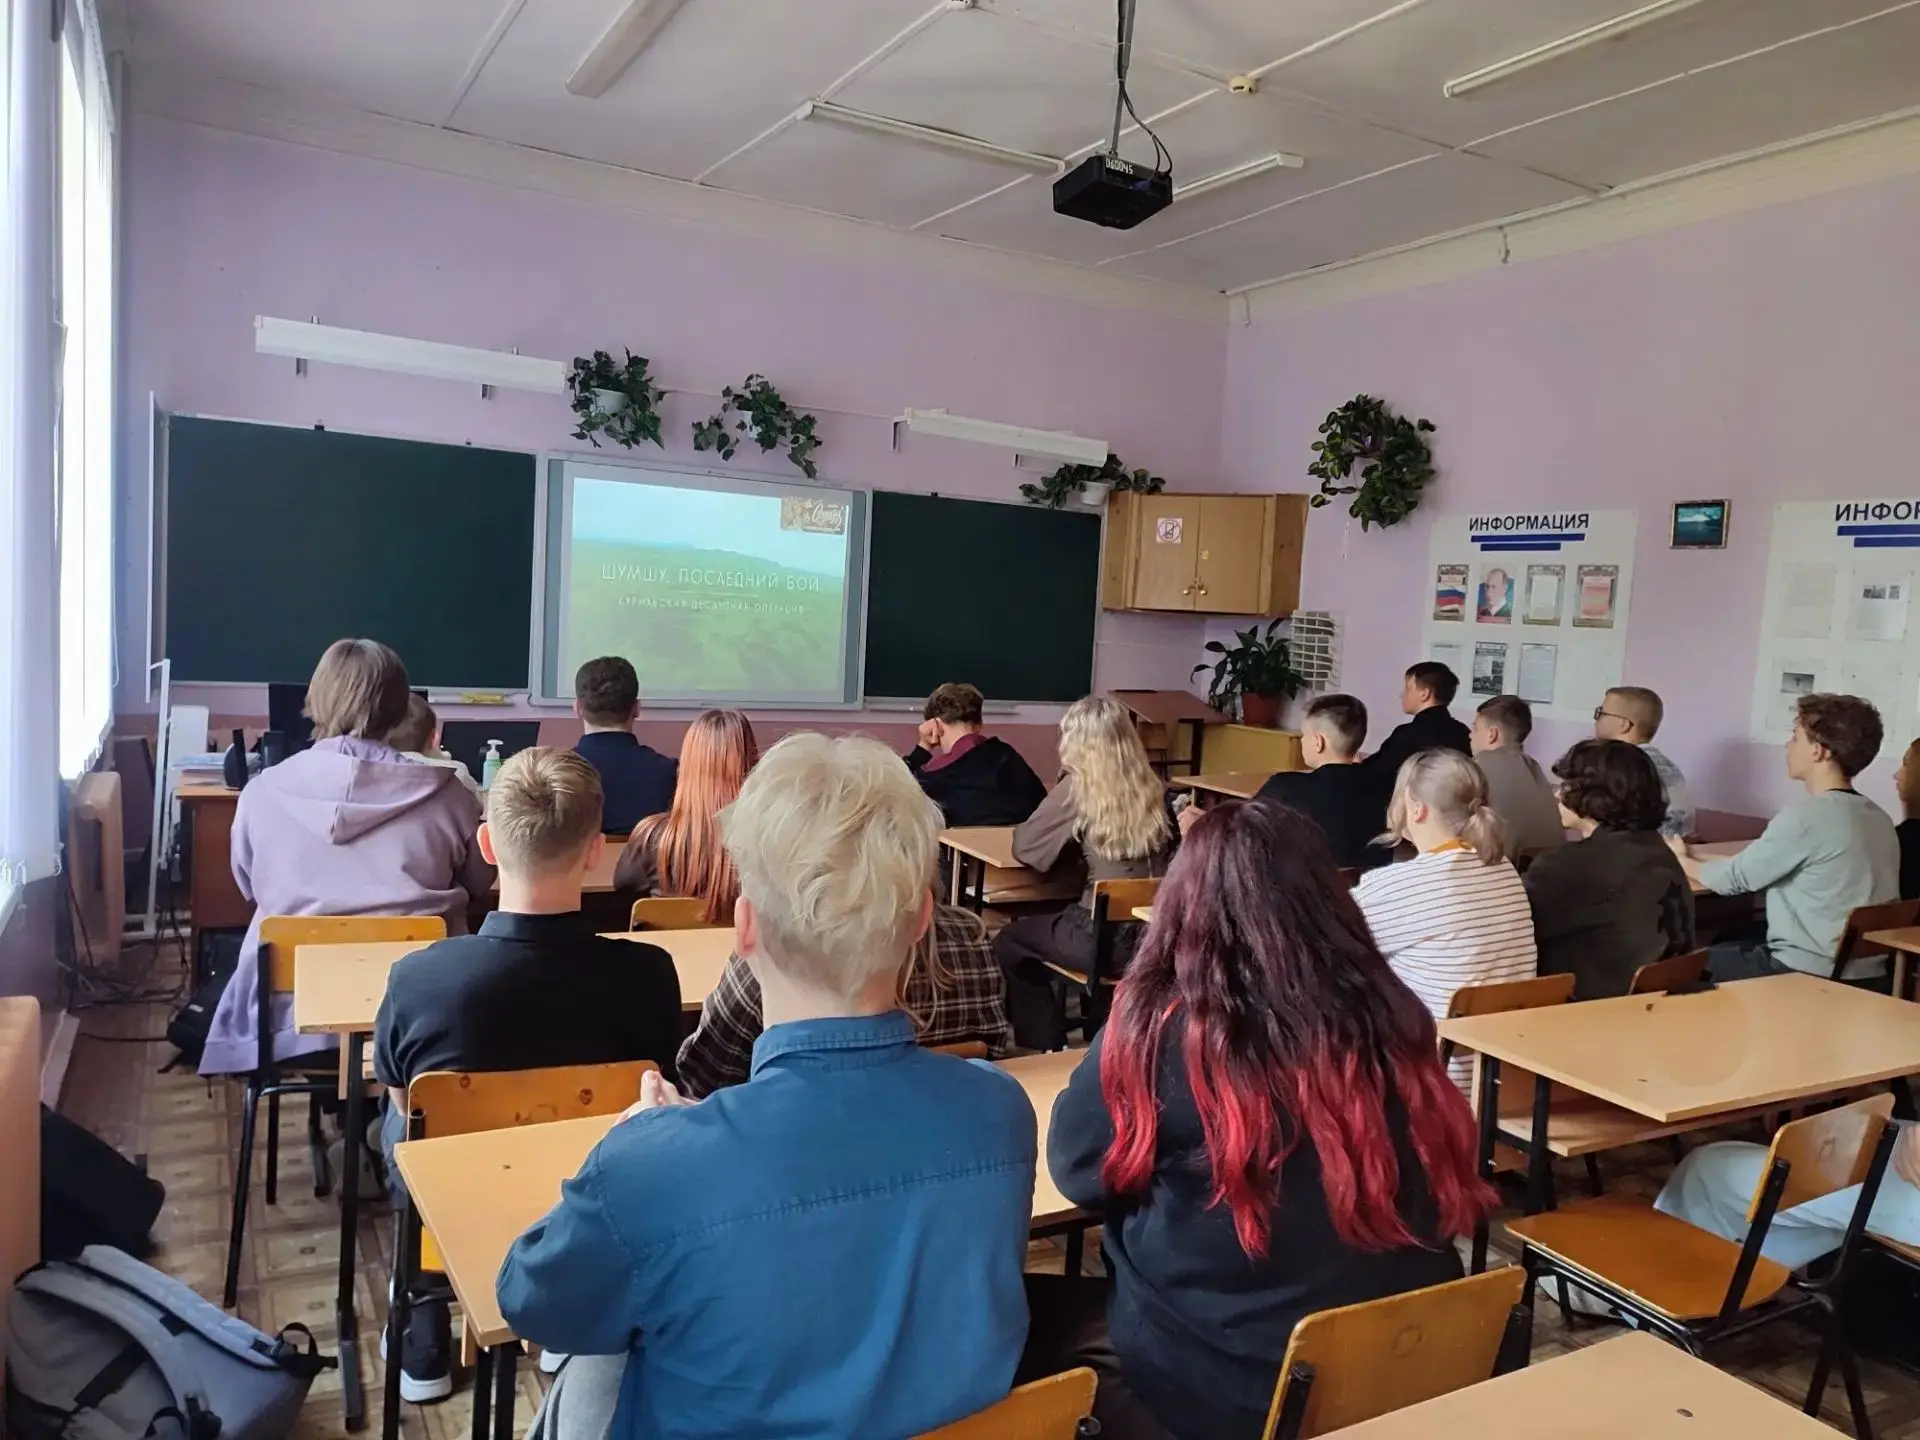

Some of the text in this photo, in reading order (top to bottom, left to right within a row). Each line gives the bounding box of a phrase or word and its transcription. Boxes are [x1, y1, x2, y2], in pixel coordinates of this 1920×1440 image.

[1469, 514, 1590, 532] ИНФОРМАЦИЯ
[678, 567, 779, 590] ПОСЛЕДНИЙ
[786, 573, 820, 592] БОЙ
